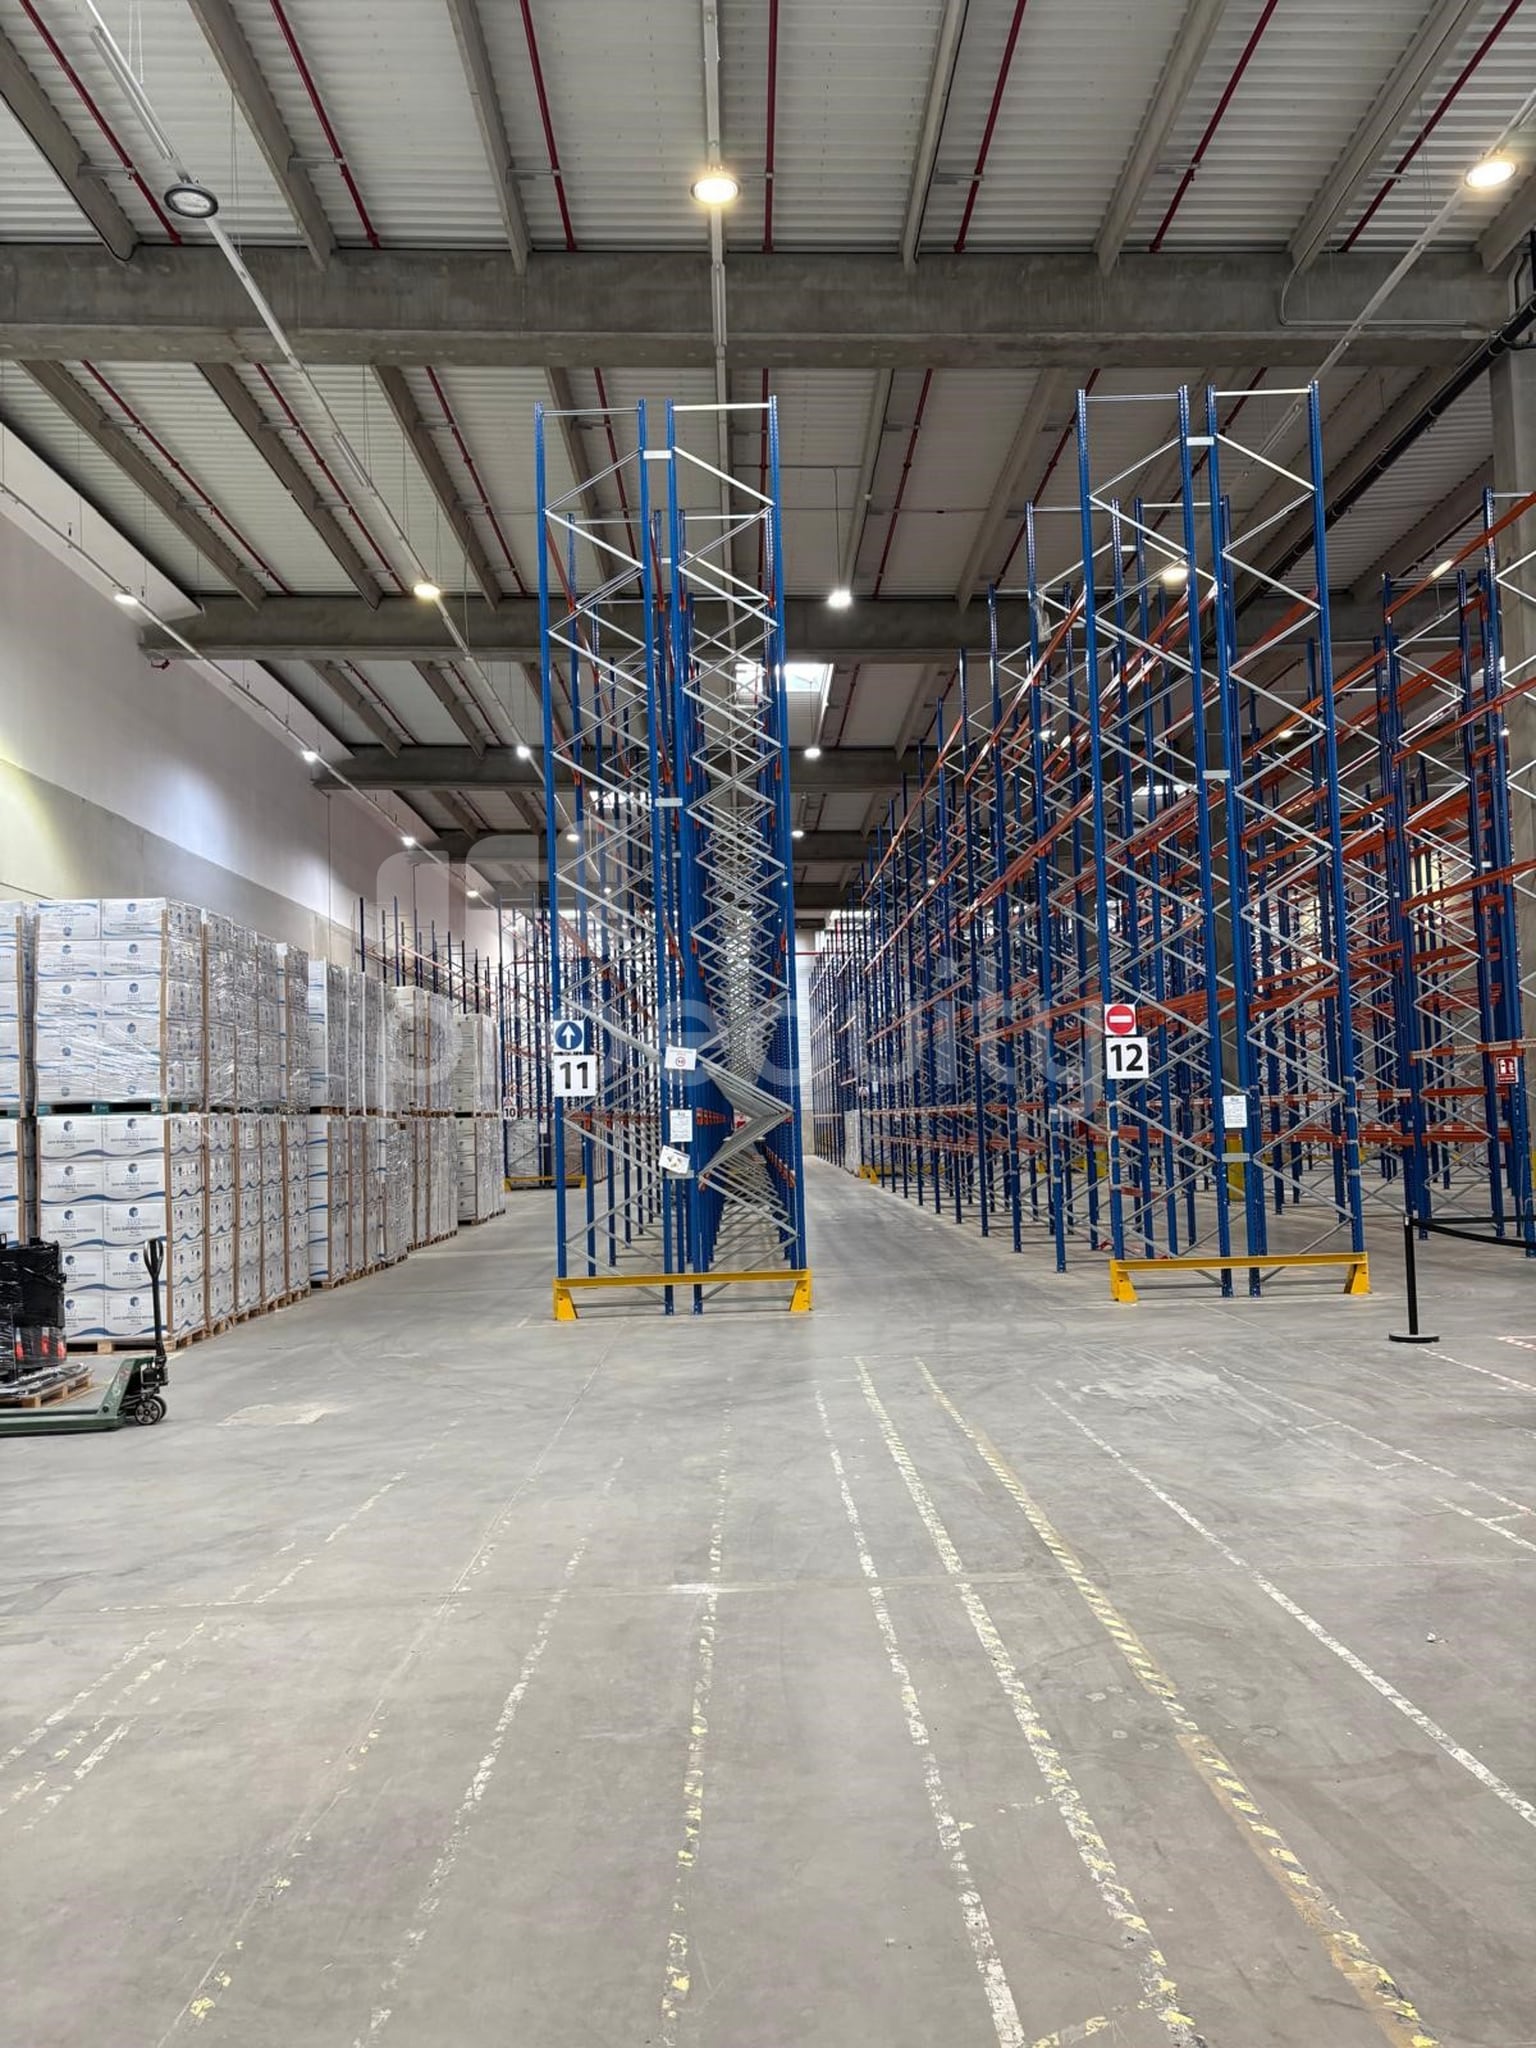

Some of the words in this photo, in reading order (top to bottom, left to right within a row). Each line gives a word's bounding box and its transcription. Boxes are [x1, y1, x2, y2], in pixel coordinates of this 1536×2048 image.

[1109, 1043, 1143, 1072] 12
[559, 1061, 589, 1090] 11
[504, 1108, 516, 1118] 10
